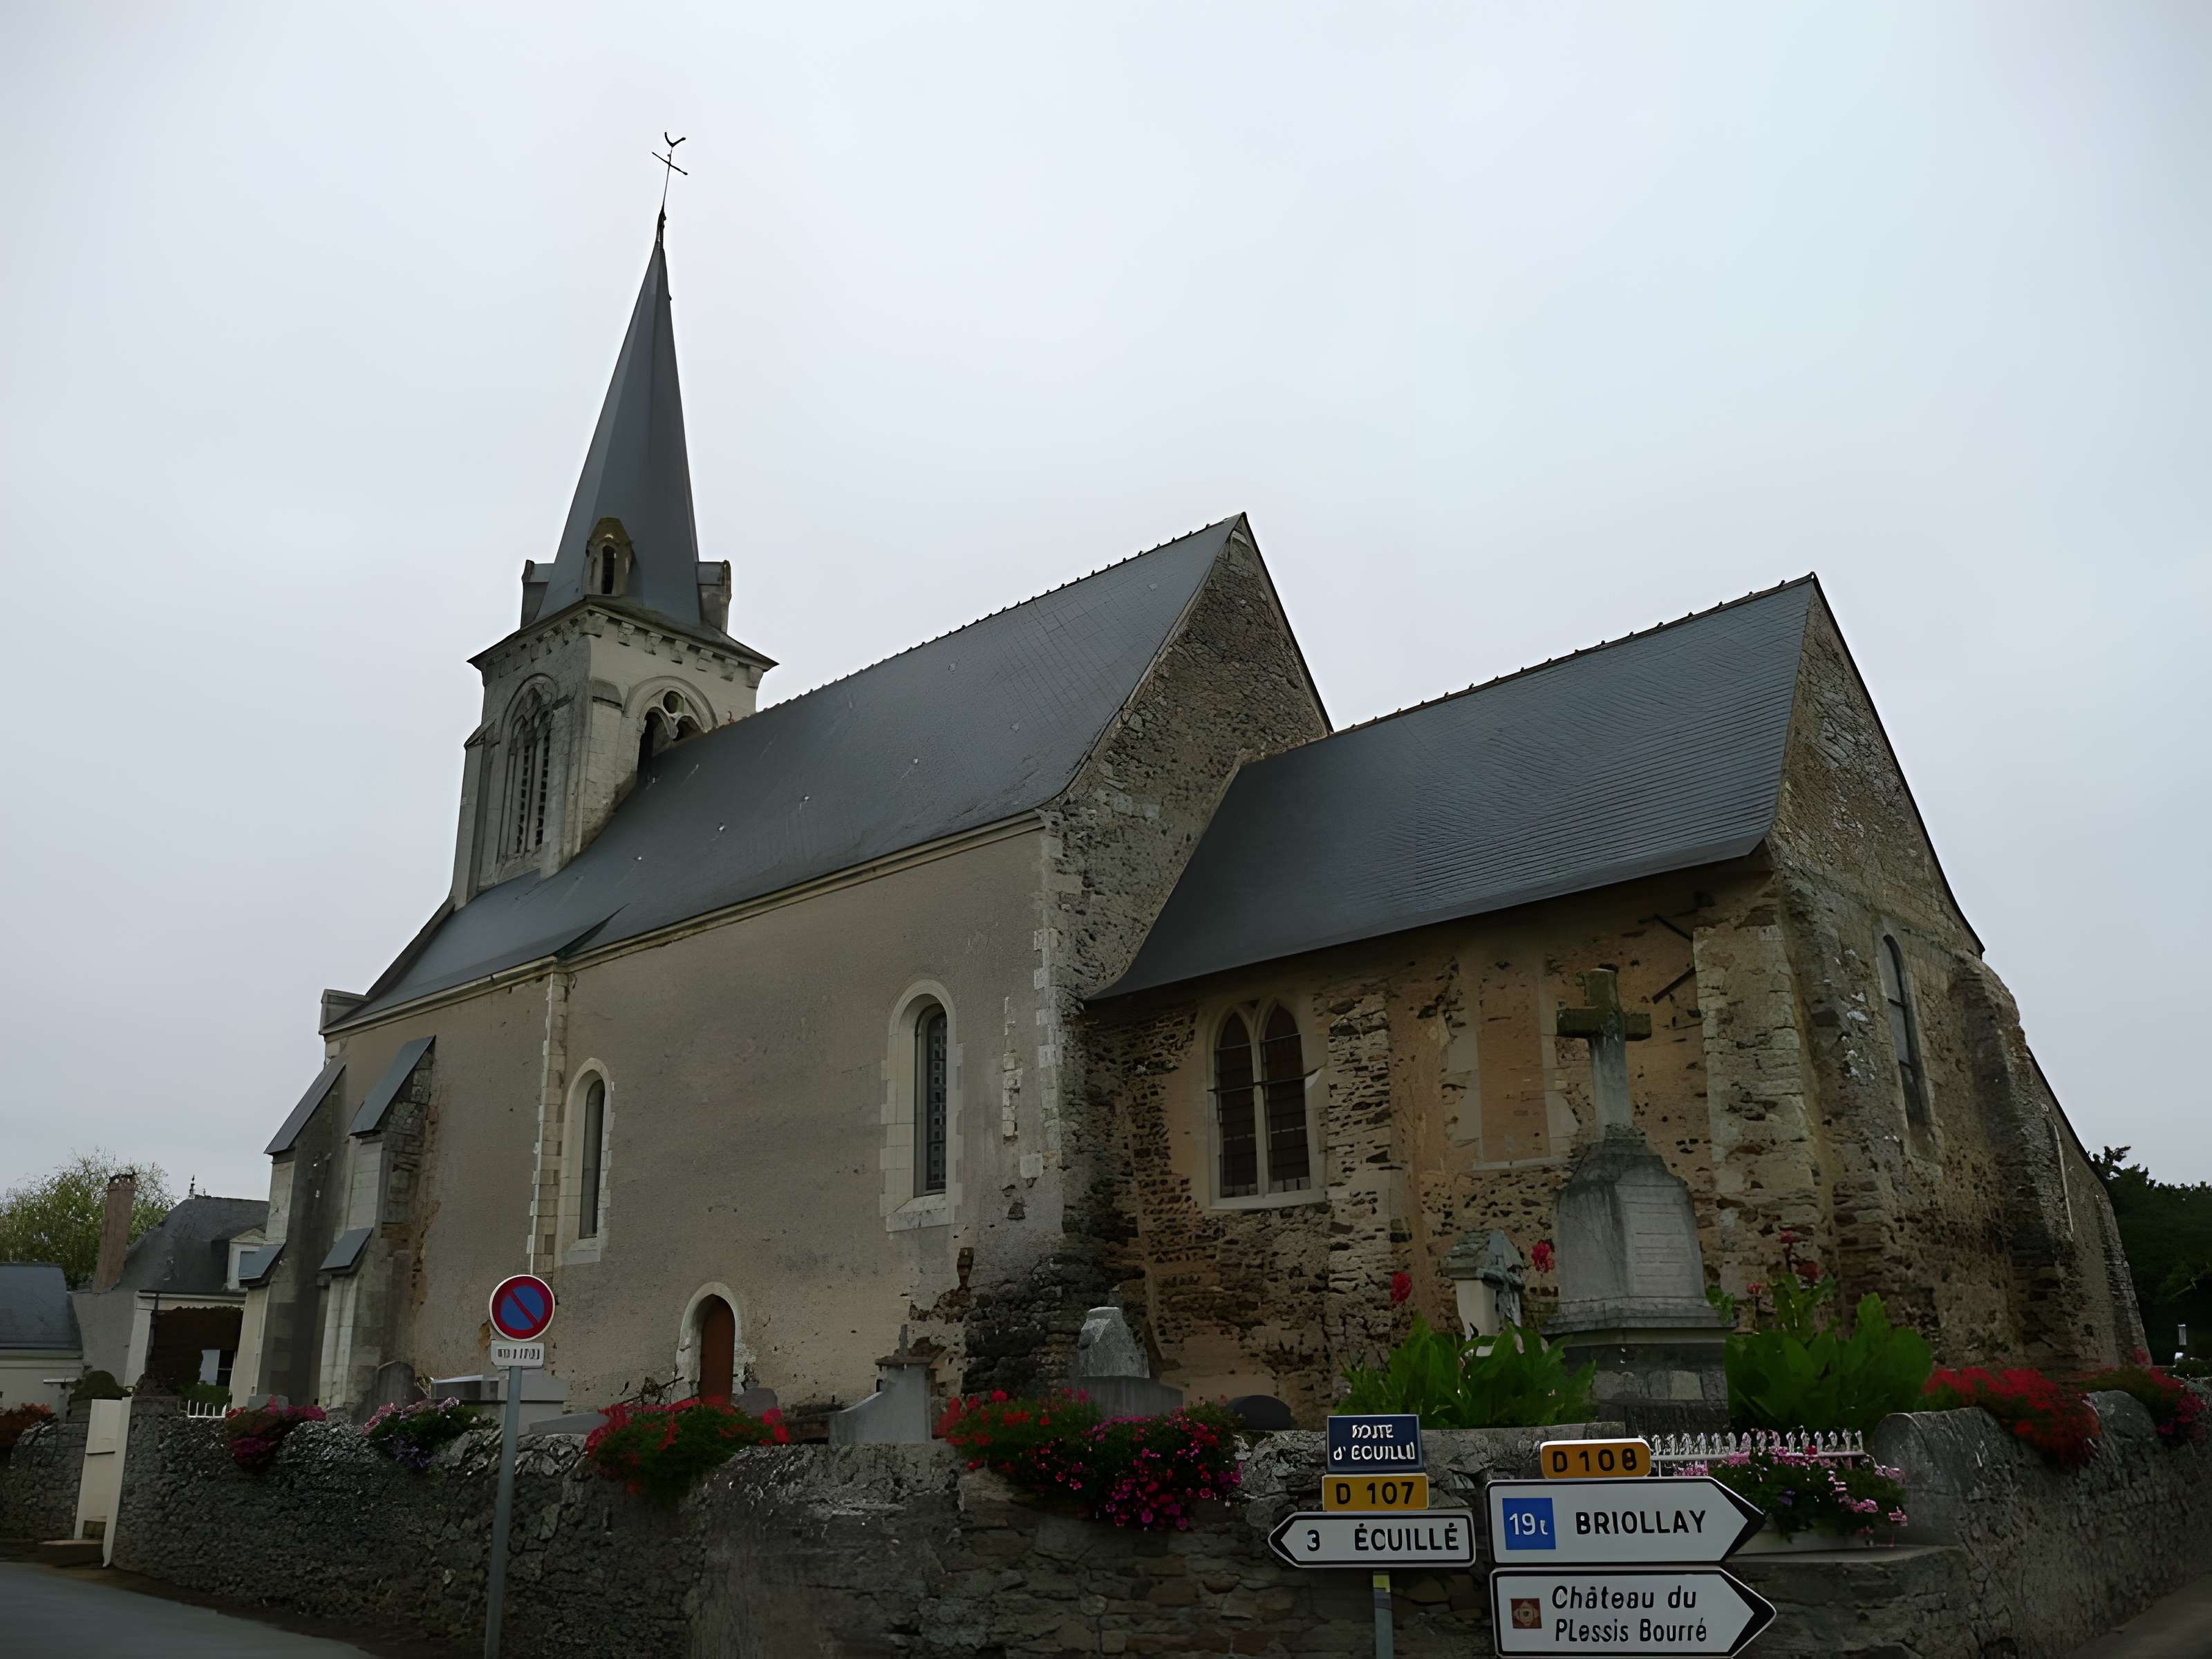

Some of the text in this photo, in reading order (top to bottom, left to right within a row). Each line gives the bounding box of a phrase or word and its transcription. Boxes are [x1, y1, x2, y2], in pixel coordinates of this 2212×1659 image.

[1553, 1448, 1637, 1472] D 108
[1335, 1482, 1414, 1504] D 107
[1575, 1510, 1706, 1535] BRIOLLAY
[1306, 1529, 1320, 1551] 3
[1552, 1585, 1696, 1609] Château du
[1555, 1617, 1707, 1642] Plessis Bourré
